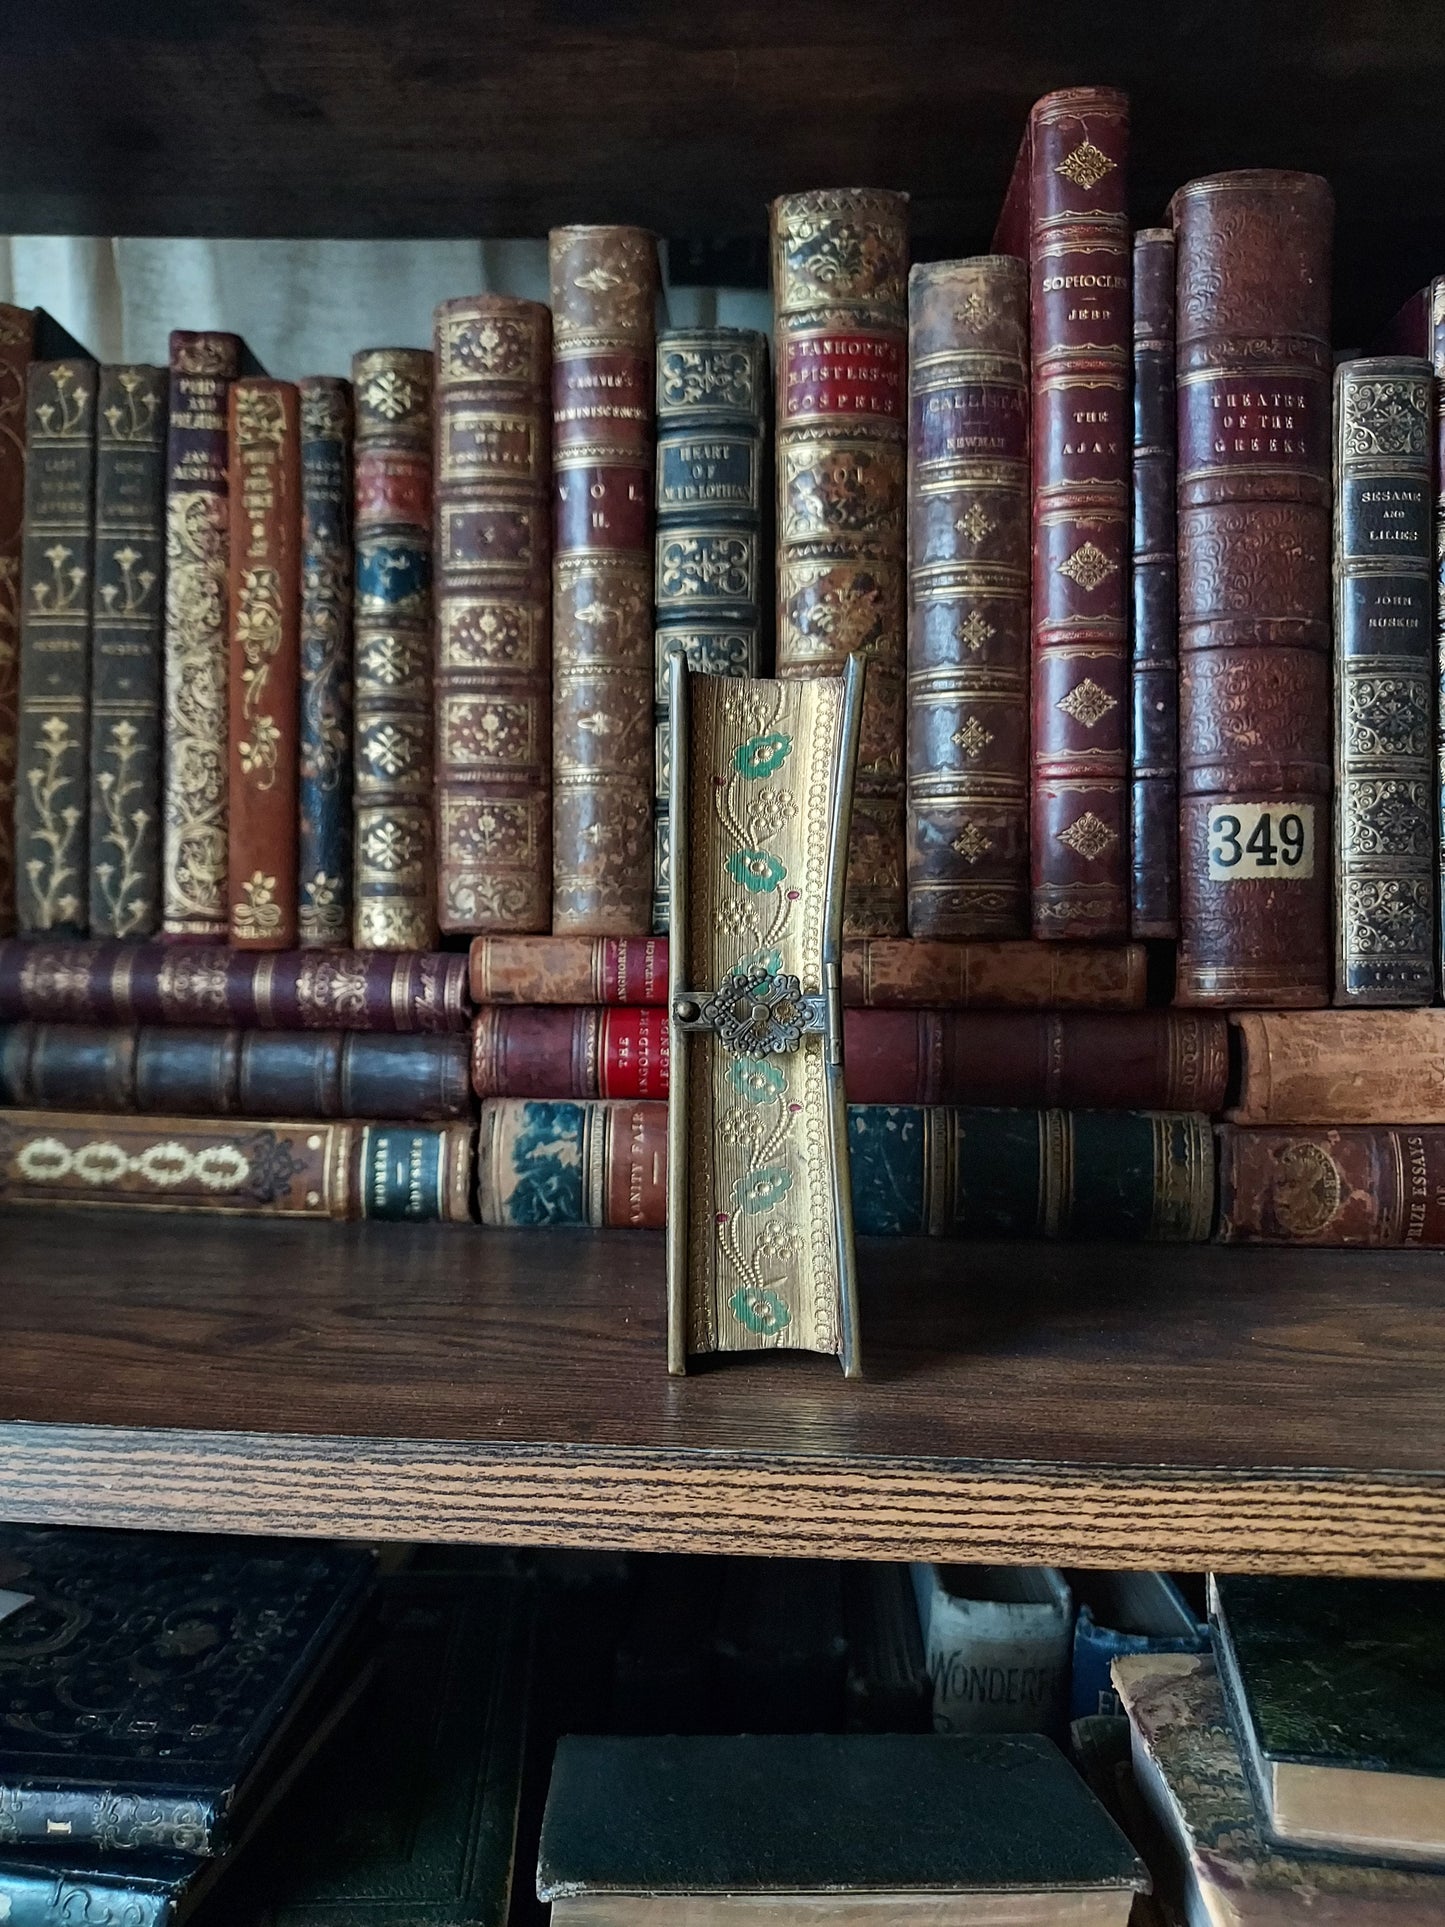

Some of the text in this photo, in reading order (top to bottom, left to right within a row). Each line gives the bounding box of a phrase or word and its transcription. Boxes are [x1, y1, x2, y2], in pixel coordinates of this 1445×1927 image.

[1043, 275, 1128, 292] SOPHOCLES
[1068, 309, 1112, 321] JEBB
[787, 394, 894, 415] GOSPELS
[928, 394, 1021, 413] CALLISTA
[1210, 394, 1305, 408] THEATRE
[1073, 411, 1110, 424] THE
[1223, 415, 1294, 429] OF THE
[946, 436, 1006, 452] NEWMAN
[1062, 442, 1117, 456] AJAX
[1214, 438, 1305, 454] GREEKS
[679, 446, 731, 463] HEART
[691, 465, 716, 479] OF
[1361, 490, 1422, 503] SESAME
[1382, 511, 1405, 519] AND
[1369, 530, 1419, 541] LILIES
[1374, 596, 1412, 606] JOHN
[1368, 617, 1419, 628] RUSKIN
[1211, 813, 1305, 868] 349
[618, 1036, 630, 1068] THE
[659, 1017, 670, 1088] LEGENDS
[629, 1112, 645, 1222] VANITY FAIR
[1405, 1136, 1427, 1245] PRIZE ESSAYS
